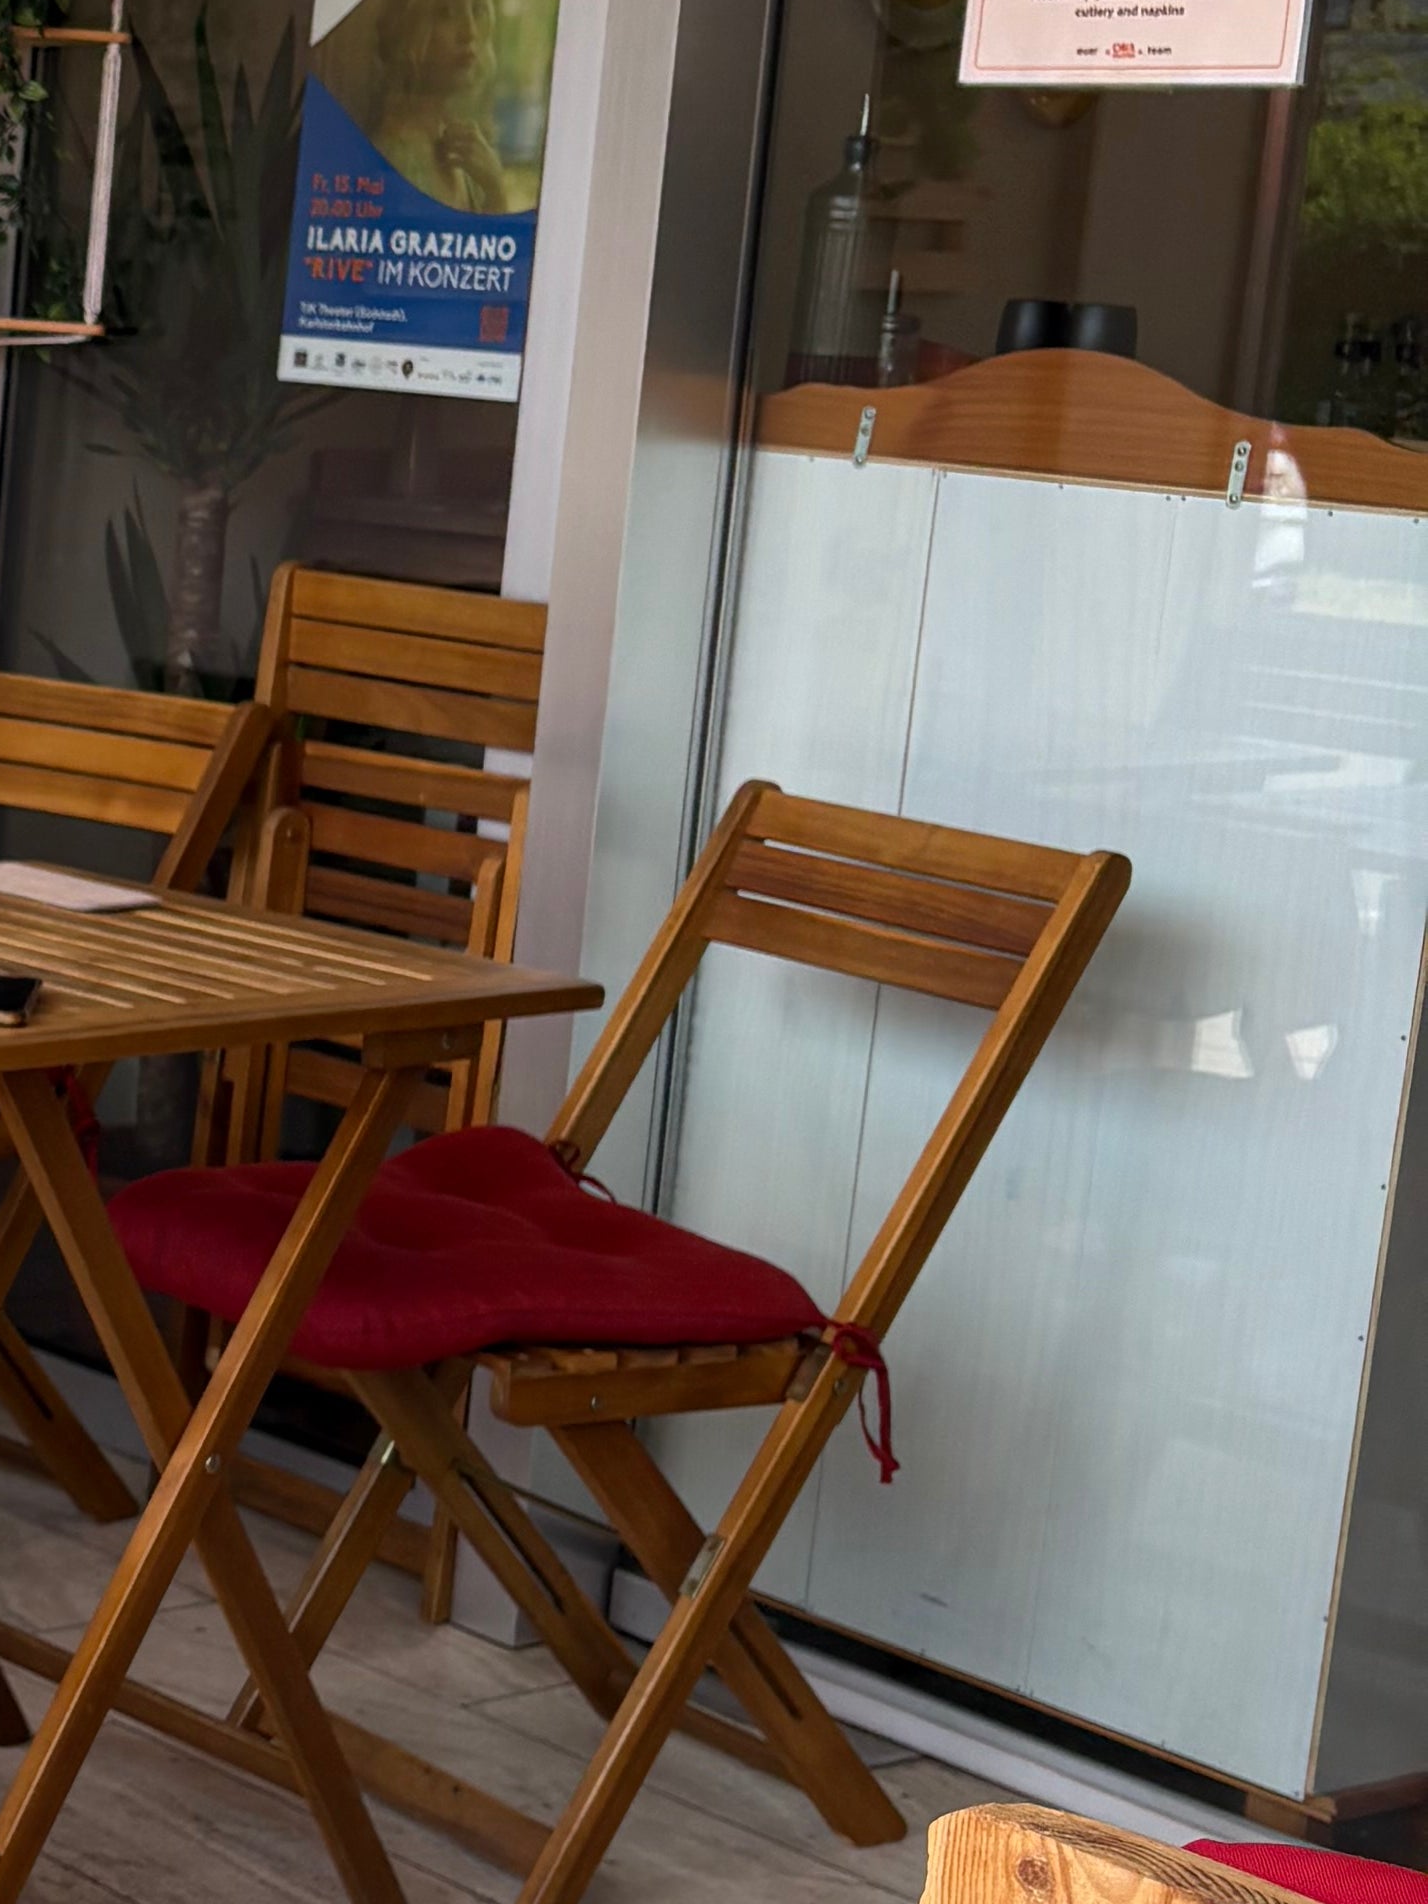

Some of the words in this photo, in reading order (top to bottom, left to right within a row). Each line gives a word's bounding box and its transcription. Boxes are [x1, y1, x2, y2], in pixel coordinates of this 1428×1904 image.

[1075, 6, 1114, 18] cutlery
[1117, 5, 1138, 16] and
[1141, 5, 1185, 18] napkins
[1147, 46, 1172, 55] team
[356, 199, 384, 218] Uhr
[307, 225, 385, 254] ILARIA
[390, 228, 516, 261] GRAZIANO
[377, 259, 403, 286] IM
[408, 261, 515, 292] KONZERT
